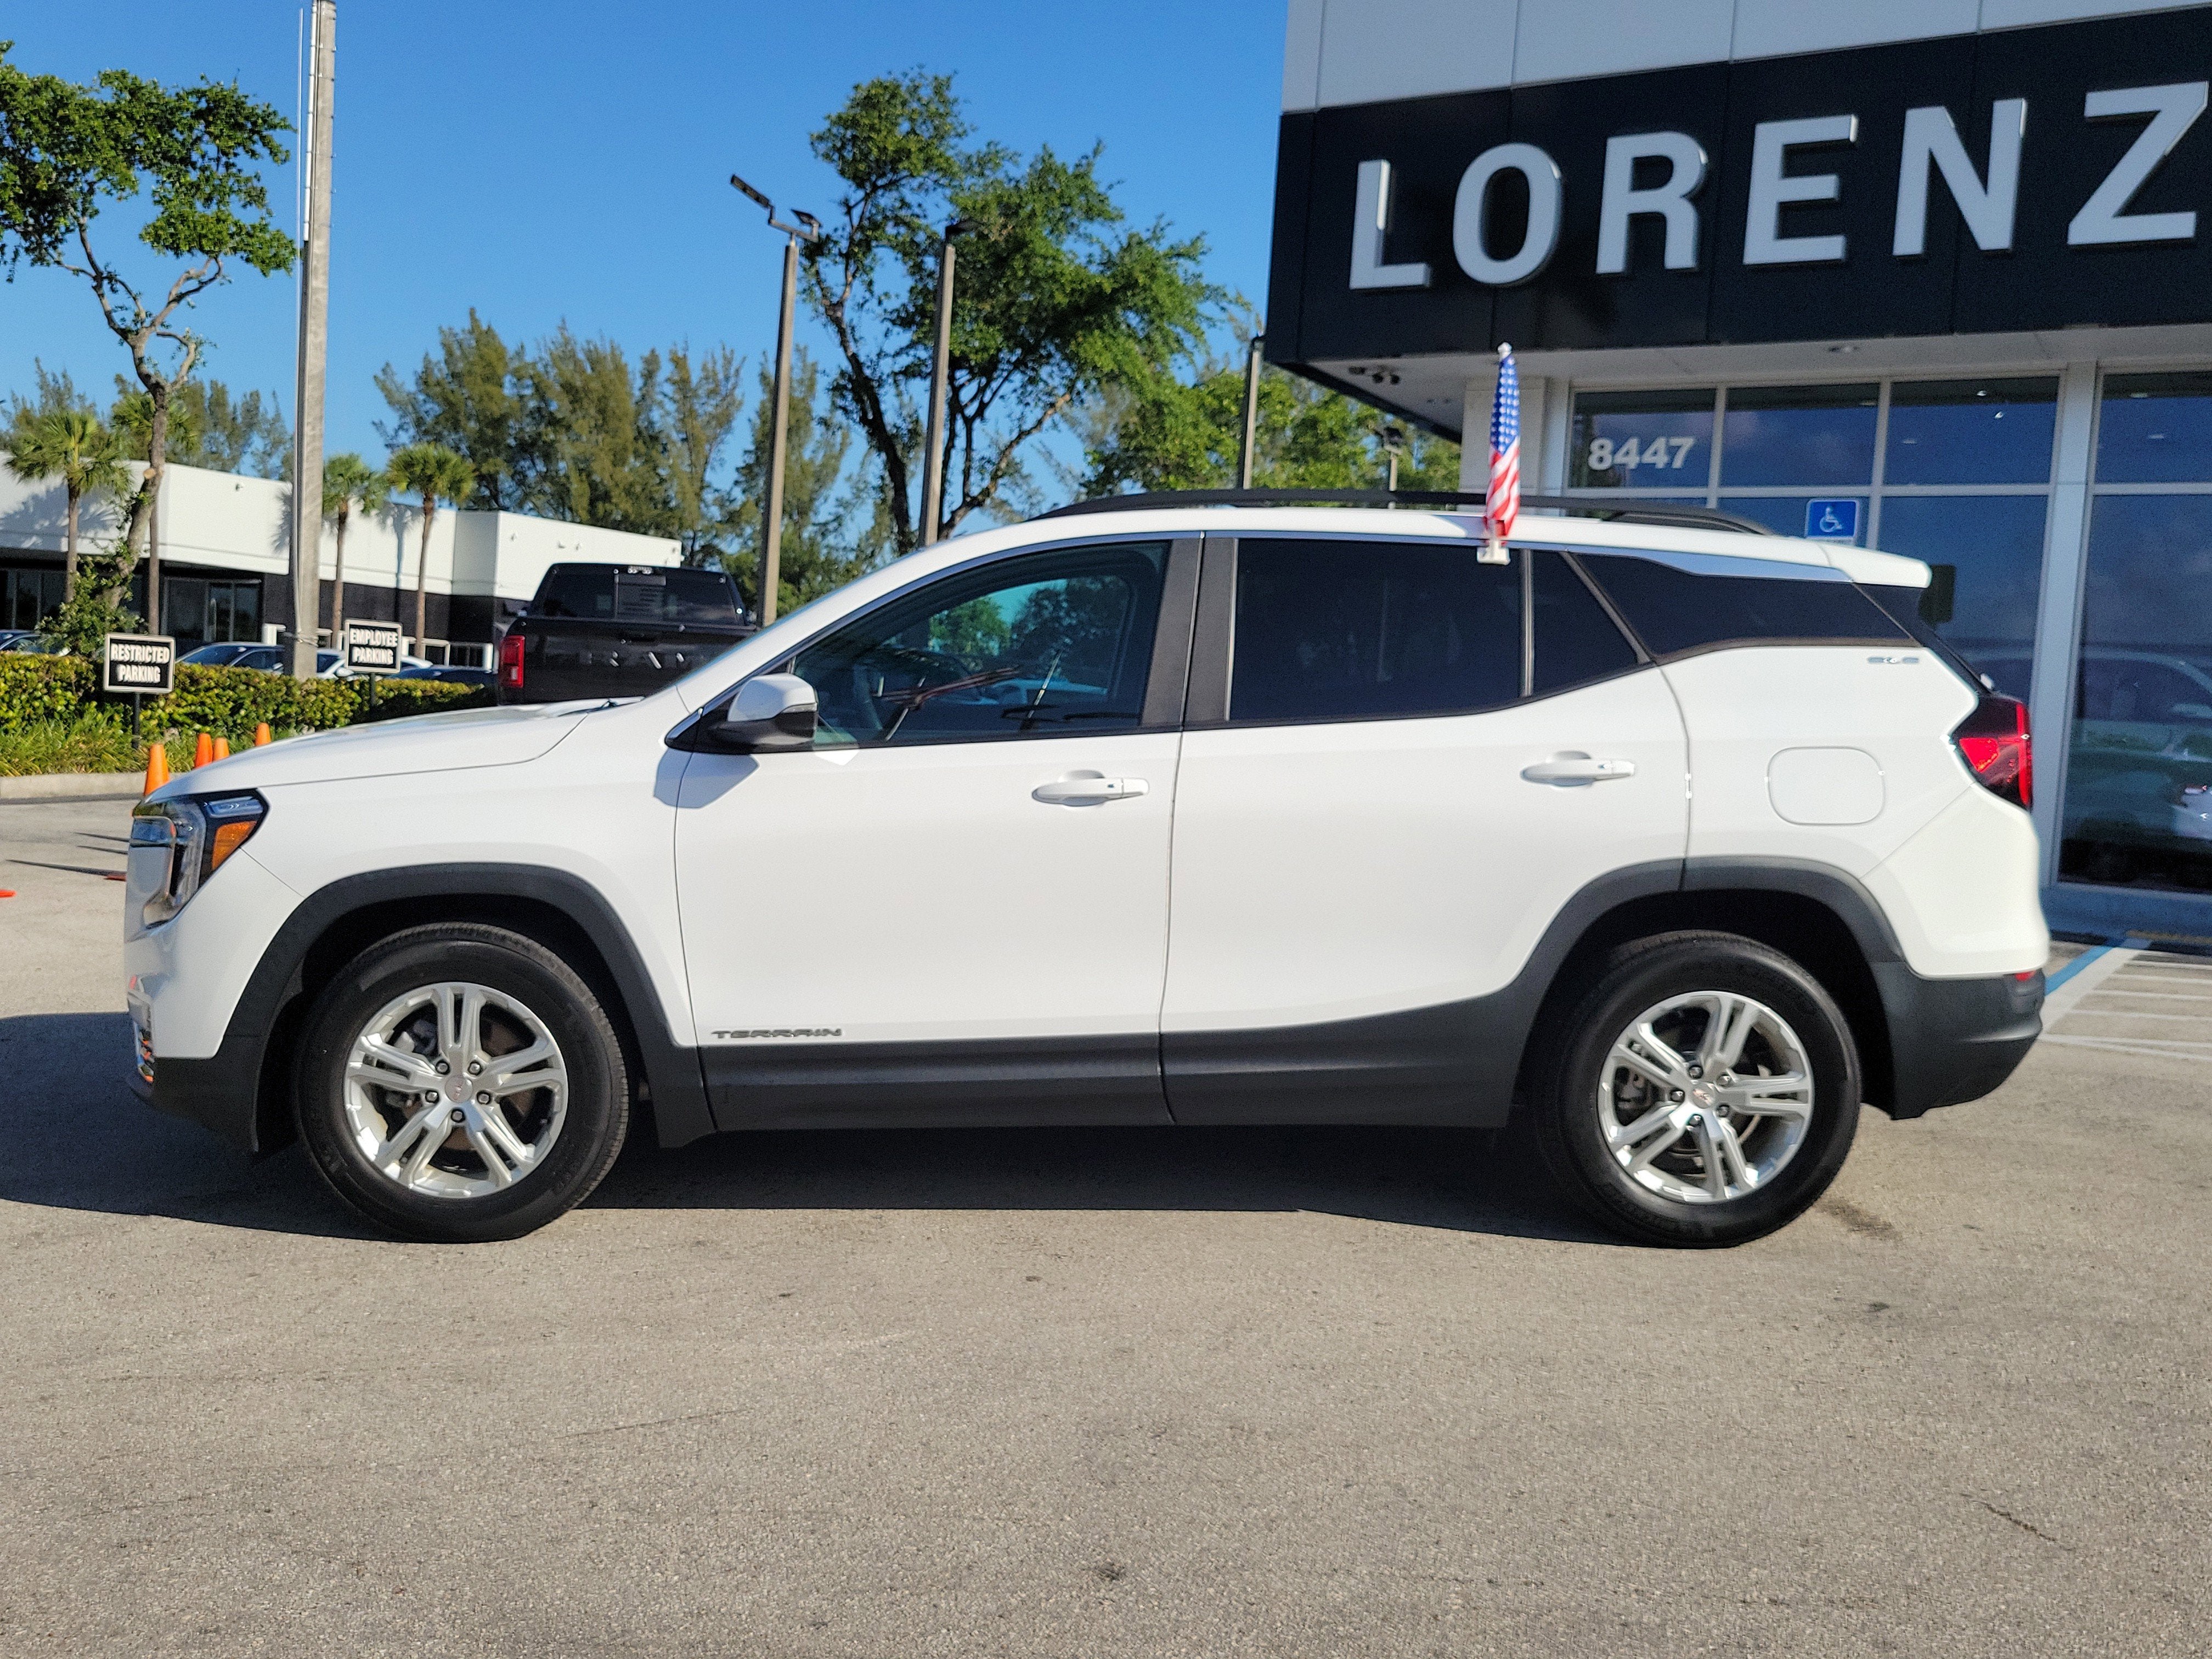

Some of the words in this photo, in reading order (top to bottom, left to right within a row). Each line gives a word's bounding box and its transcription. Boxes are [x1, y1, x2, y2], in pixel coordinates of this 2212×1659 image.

[1349, 81, 2209, 290] LORENZ
[1588, 437, 1695, 470] 8447
[349, 628, 398, 647] EMPLOYEE
[110, 642, 170, 664] RESTRICTED
[352, 646, 393, 665] PARKING
[117, 663, 160, 684] PARKING
[711, 1028, 842, 1039] TERRAIN
